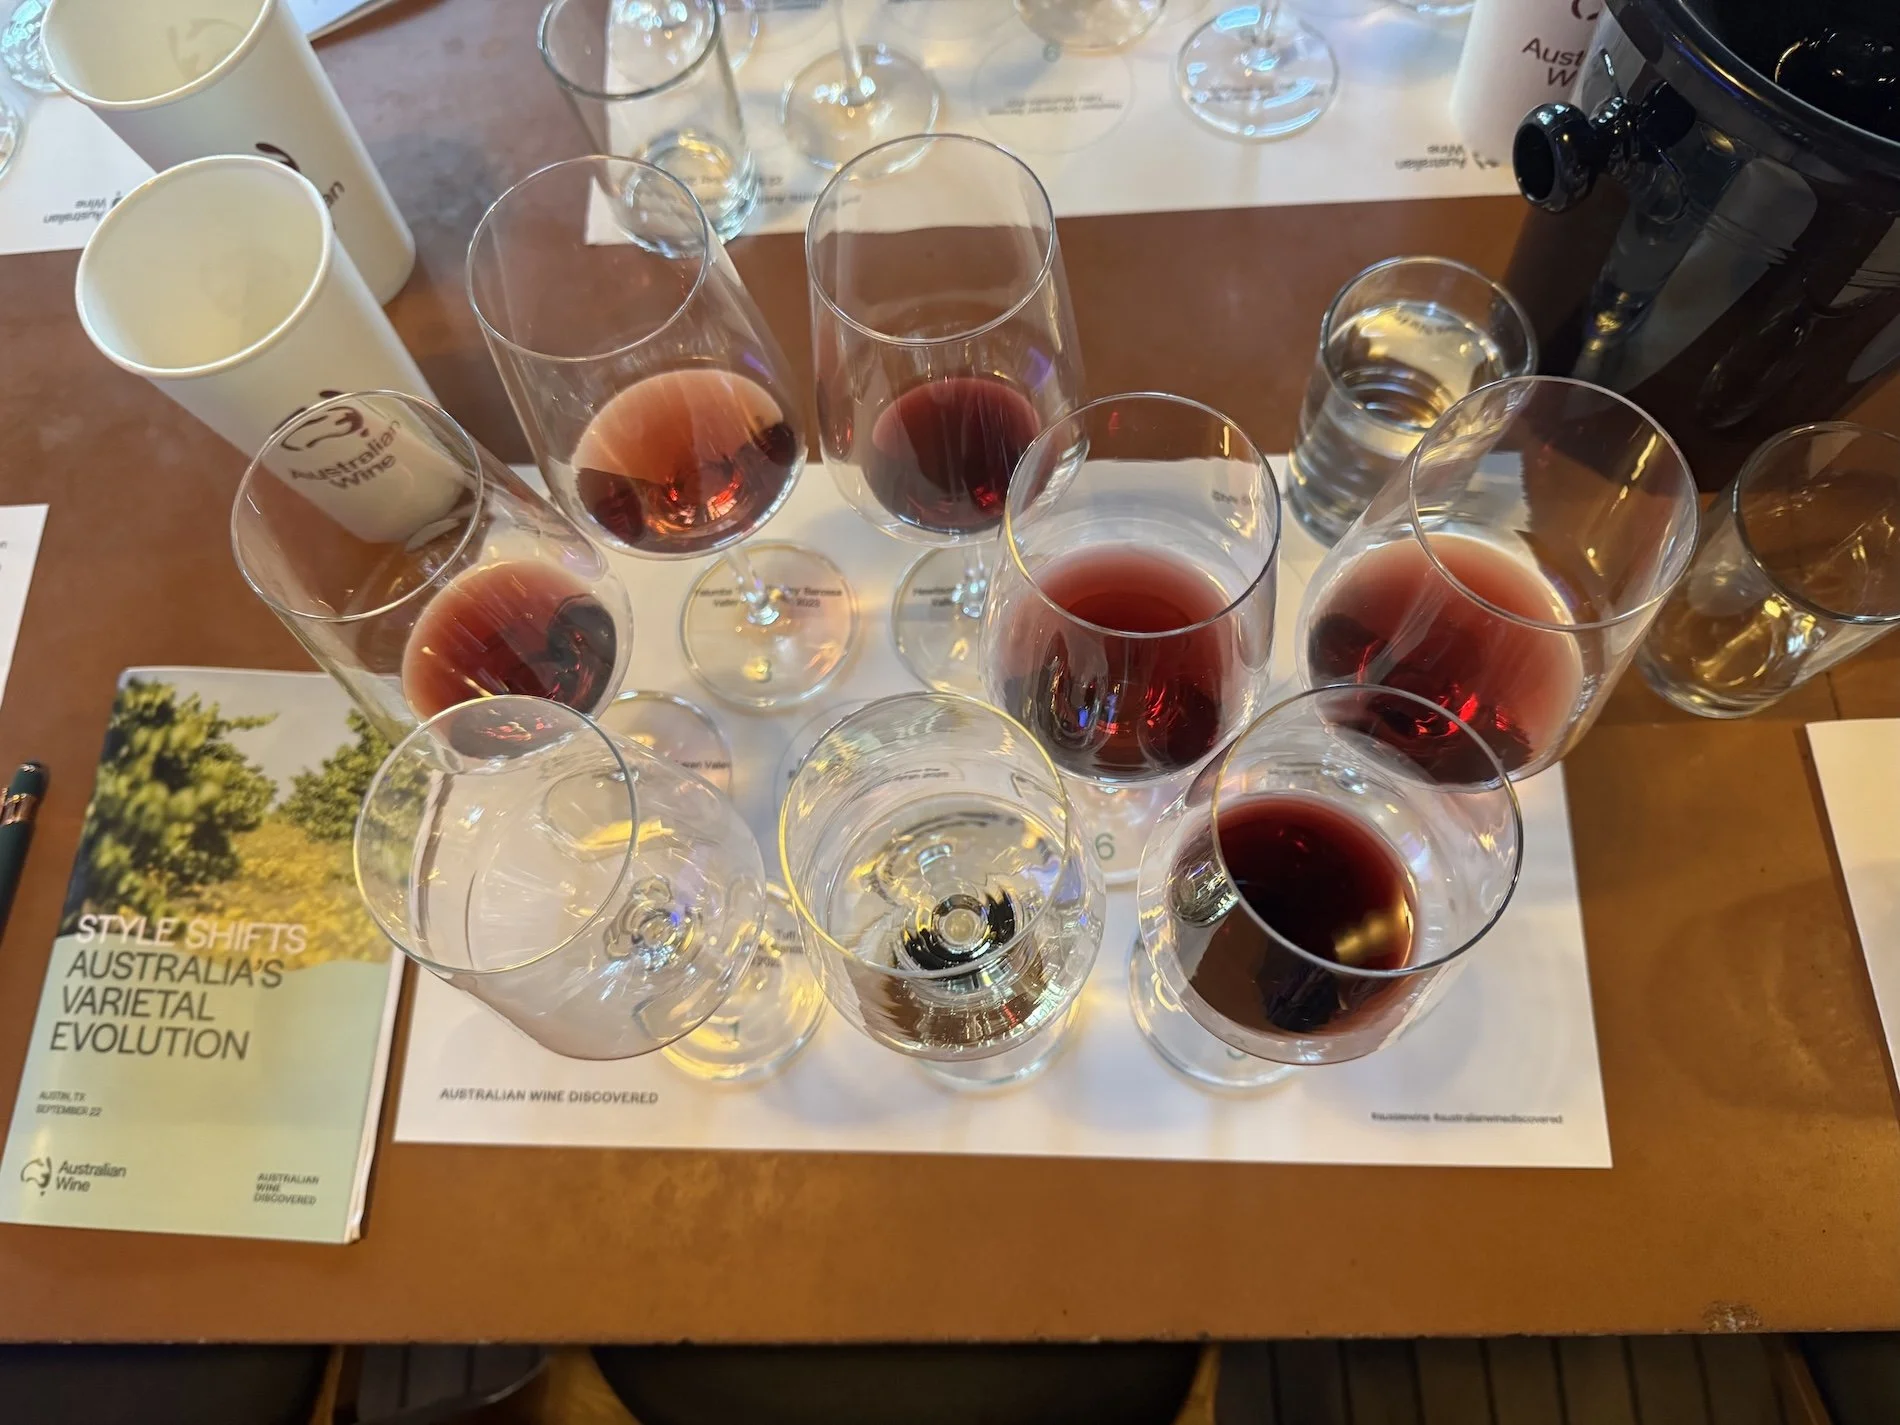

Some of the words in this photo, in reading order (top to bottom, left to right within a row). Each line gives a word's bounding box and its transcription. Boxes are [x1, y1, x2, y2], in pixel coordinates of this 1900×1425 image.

[289, 420, 401, 480] Australian
[329, 454, 396, 489] Wine
[1095, 832, 1115, 860] 6
[76, 914, 178, 948] STYLE
[184, 918, 308, 954] SHIFTS
[66, 950, 285, 988] AUSTRALIA'S
[62, 985, 215, 1021] VARIETAL
[50, 1021, 249, 1060] EVOLUTION
[439, 1088, 526, 1101] AUSTRALIAN
[530, 1090, 564, 1103] WINE
[568, 1091, 659, 1105] DISCOVERED
[55, 1176, 91, 1192] Wine
[58, 1160, 127, 1178] Australian
